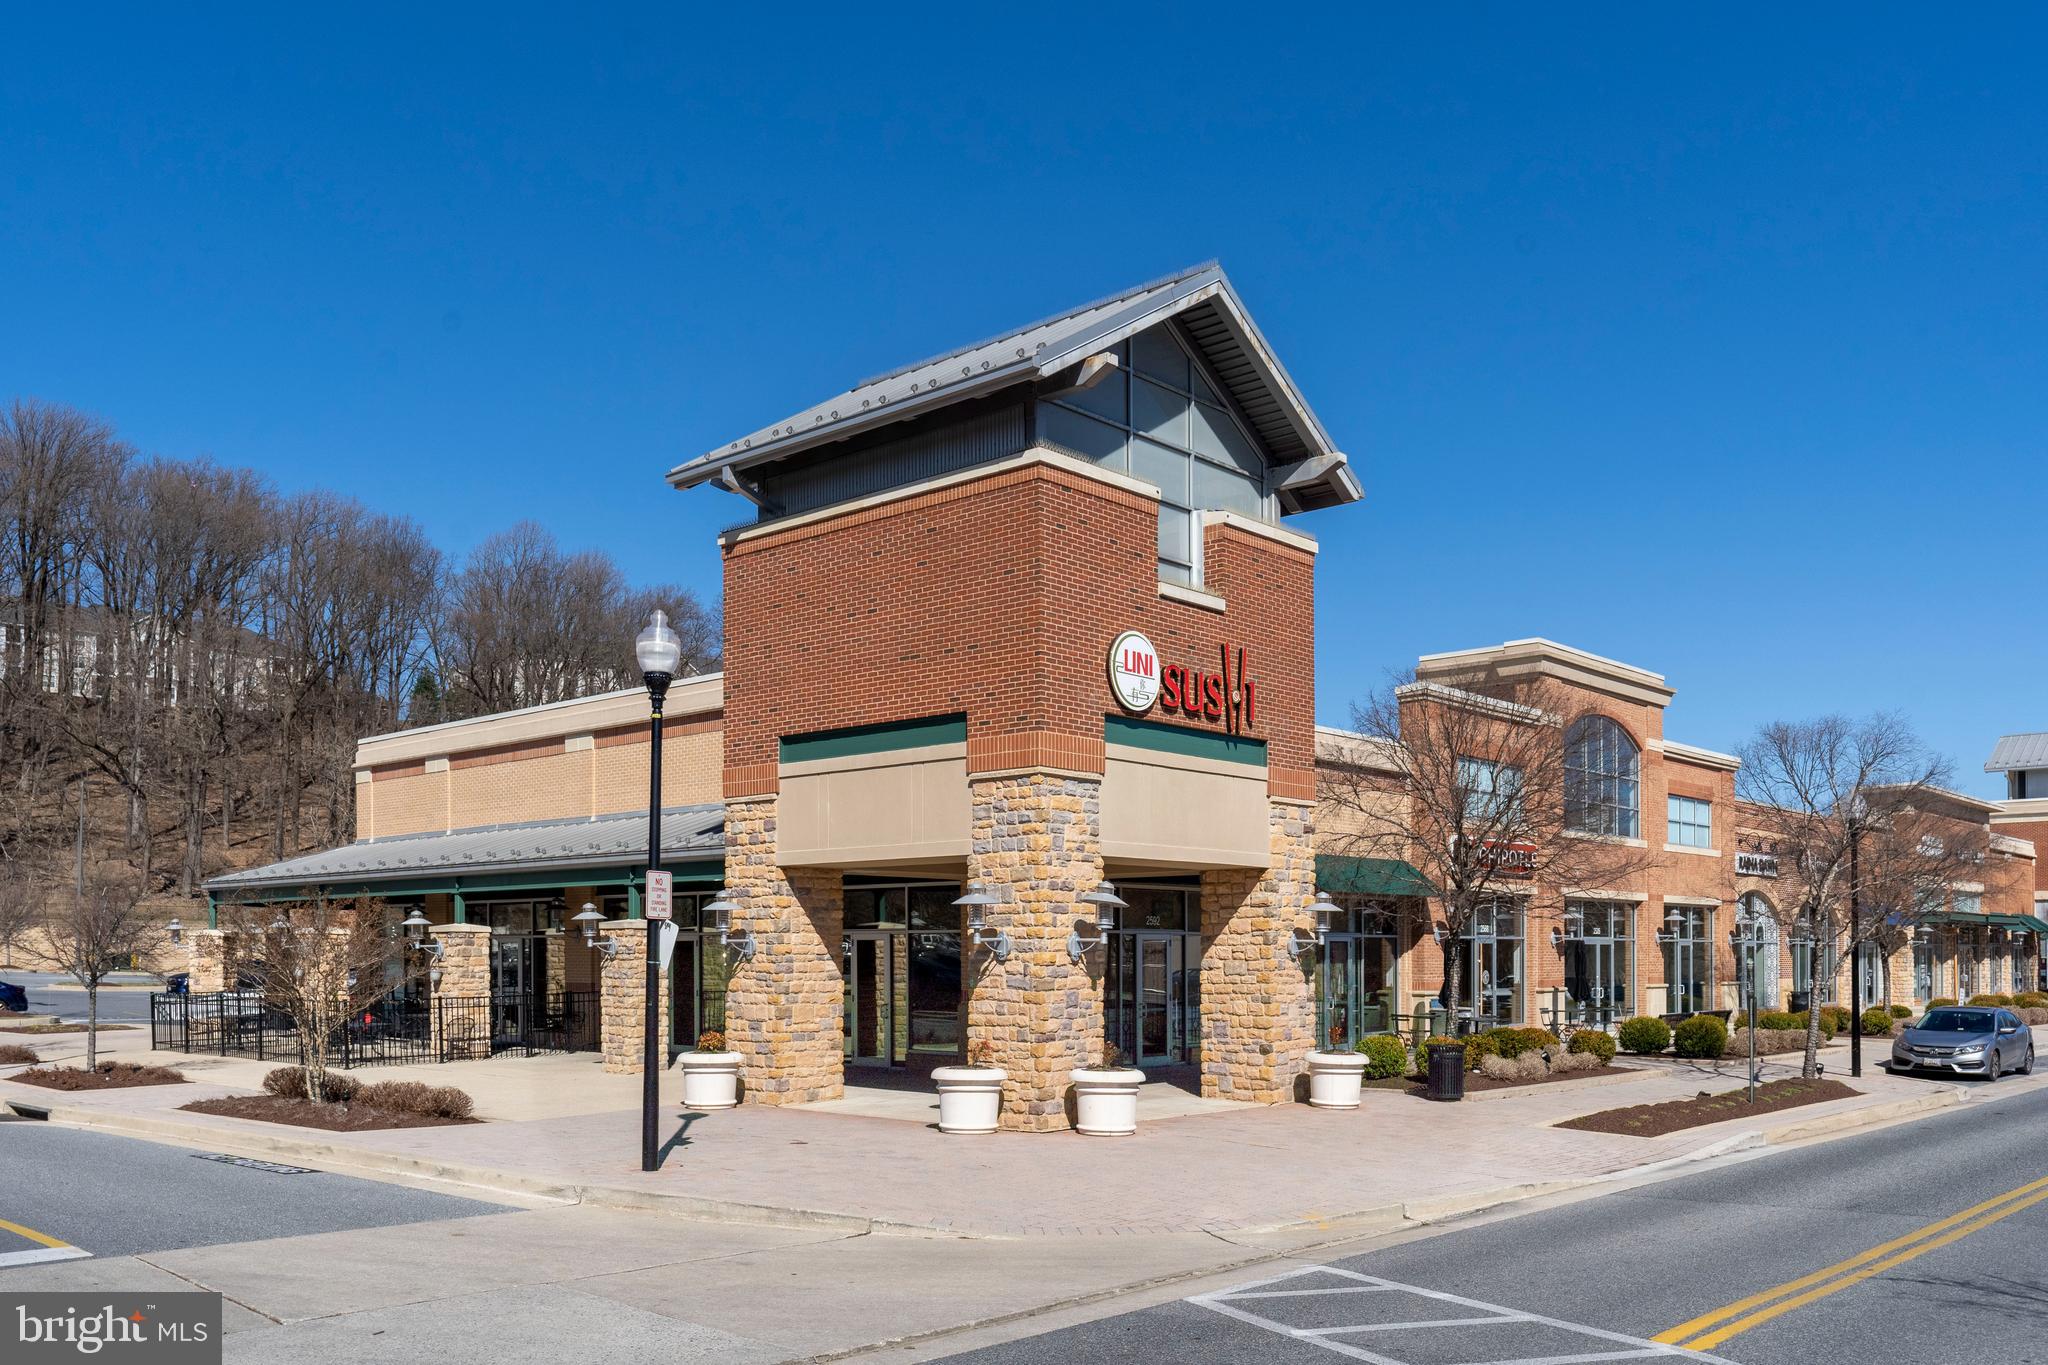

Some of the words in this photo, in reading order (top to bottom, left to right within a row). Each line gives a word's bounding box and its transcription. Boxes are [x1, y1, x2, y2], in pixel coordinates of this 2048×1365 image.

[1124, 649, 1153, 677] LINI
[655, 878, 663, 886] NO
[1145, 915, 1161, 926] 2592
